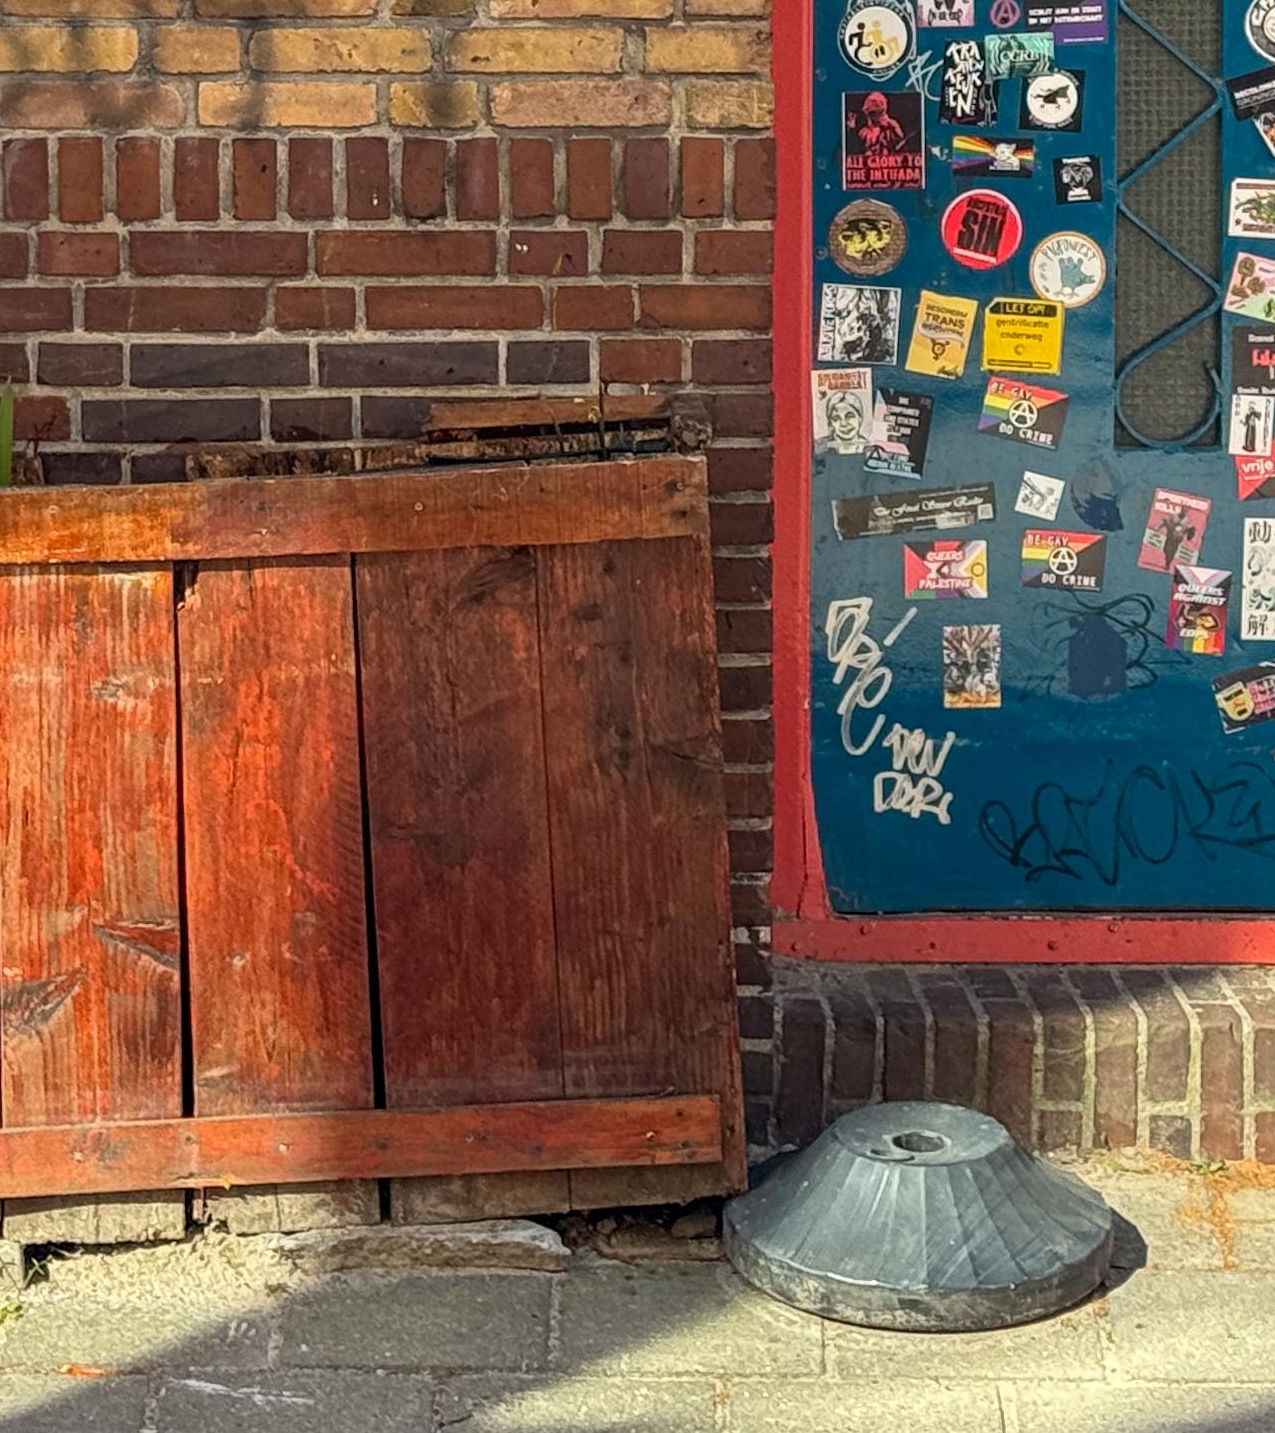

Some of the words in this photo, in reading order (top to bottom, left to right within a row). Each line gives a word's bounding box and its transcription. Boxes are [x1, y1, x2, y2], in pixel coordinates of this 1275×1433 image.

[847, 156, 866, 168] ALL
[867, 155, 903, 167] GLORY
[904, 155, 923, 167] TO
[847, 168, 867, 181] THE
[1006, 304, 1024, 314] LET
[925, 312, 966, 330] TRANS
[996, 318, 1050, 329] gentrificatie
[990, 381, 1008, 394] BE
[1010, 387, 1035, 401] GAY
[999, 423, 1014, 435] DO
[1019, 427, 1054, 444] CRIME
[1242, 457, 1274, 474] vrije
[1027, 533, 1046, 545] BE
[1048, 535, 1070, 548] GAY
[926, 550, 965, 562] QUEERS
[918, 578, 974, 590] PALESTINE
[1041, 573, 1058, 584] DO
[1062, 574, 1097, 587] CRIME
[1177, 584, 1225, 597] QUEERS
[1173, 592, 1226, 607] AGAINST
